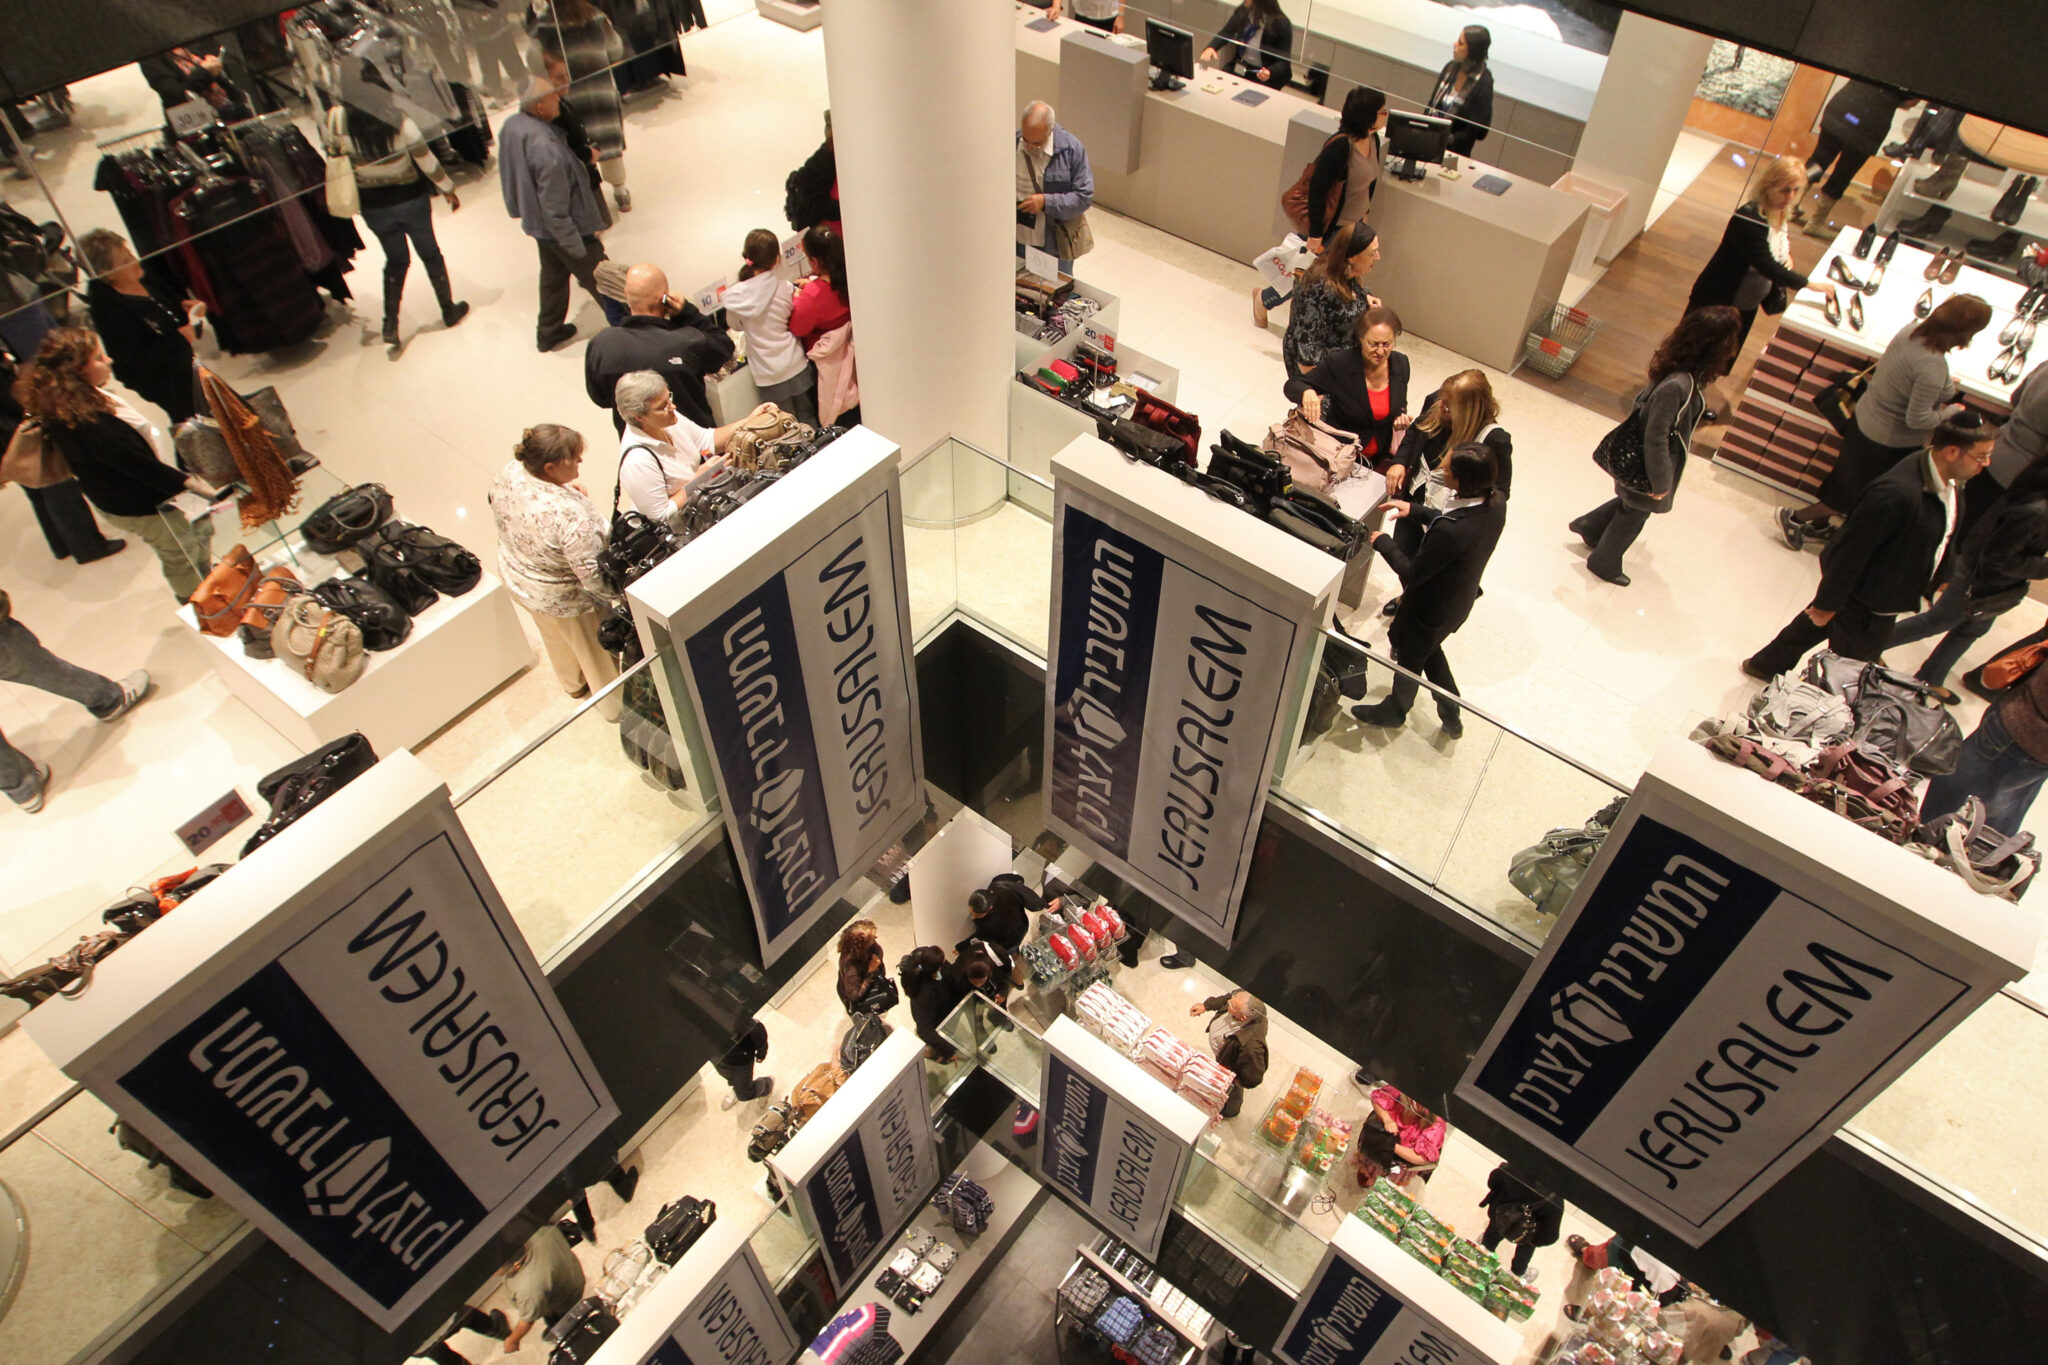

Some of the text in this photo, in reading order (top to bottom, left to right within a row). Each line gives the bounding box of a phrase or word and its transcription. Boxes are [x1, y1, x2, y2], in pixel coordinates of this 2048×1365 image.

[722, 606, 825, 914] המשביר לצרכן
[818, 534, 891, 831] JERUSALEM
[1071, 538, 1135, 842] המשביר לצרכן
[1158, 603, 1253, 892] JERUSALEM
[187, 825, 212, 846] 20
[347, 887, 561, 1162] JERUSALEM
[1510, 854, 1731, 1126] המשביר לצרכן
[1624, 941, 1894, 1190] JERUSALEM
[188, 1006, 465, 1272] המשביר לצרכן
[877, 1088, 920, 1210] JERUSALEM
[1107, 1119, 1158, 1233] JERUSALEM
